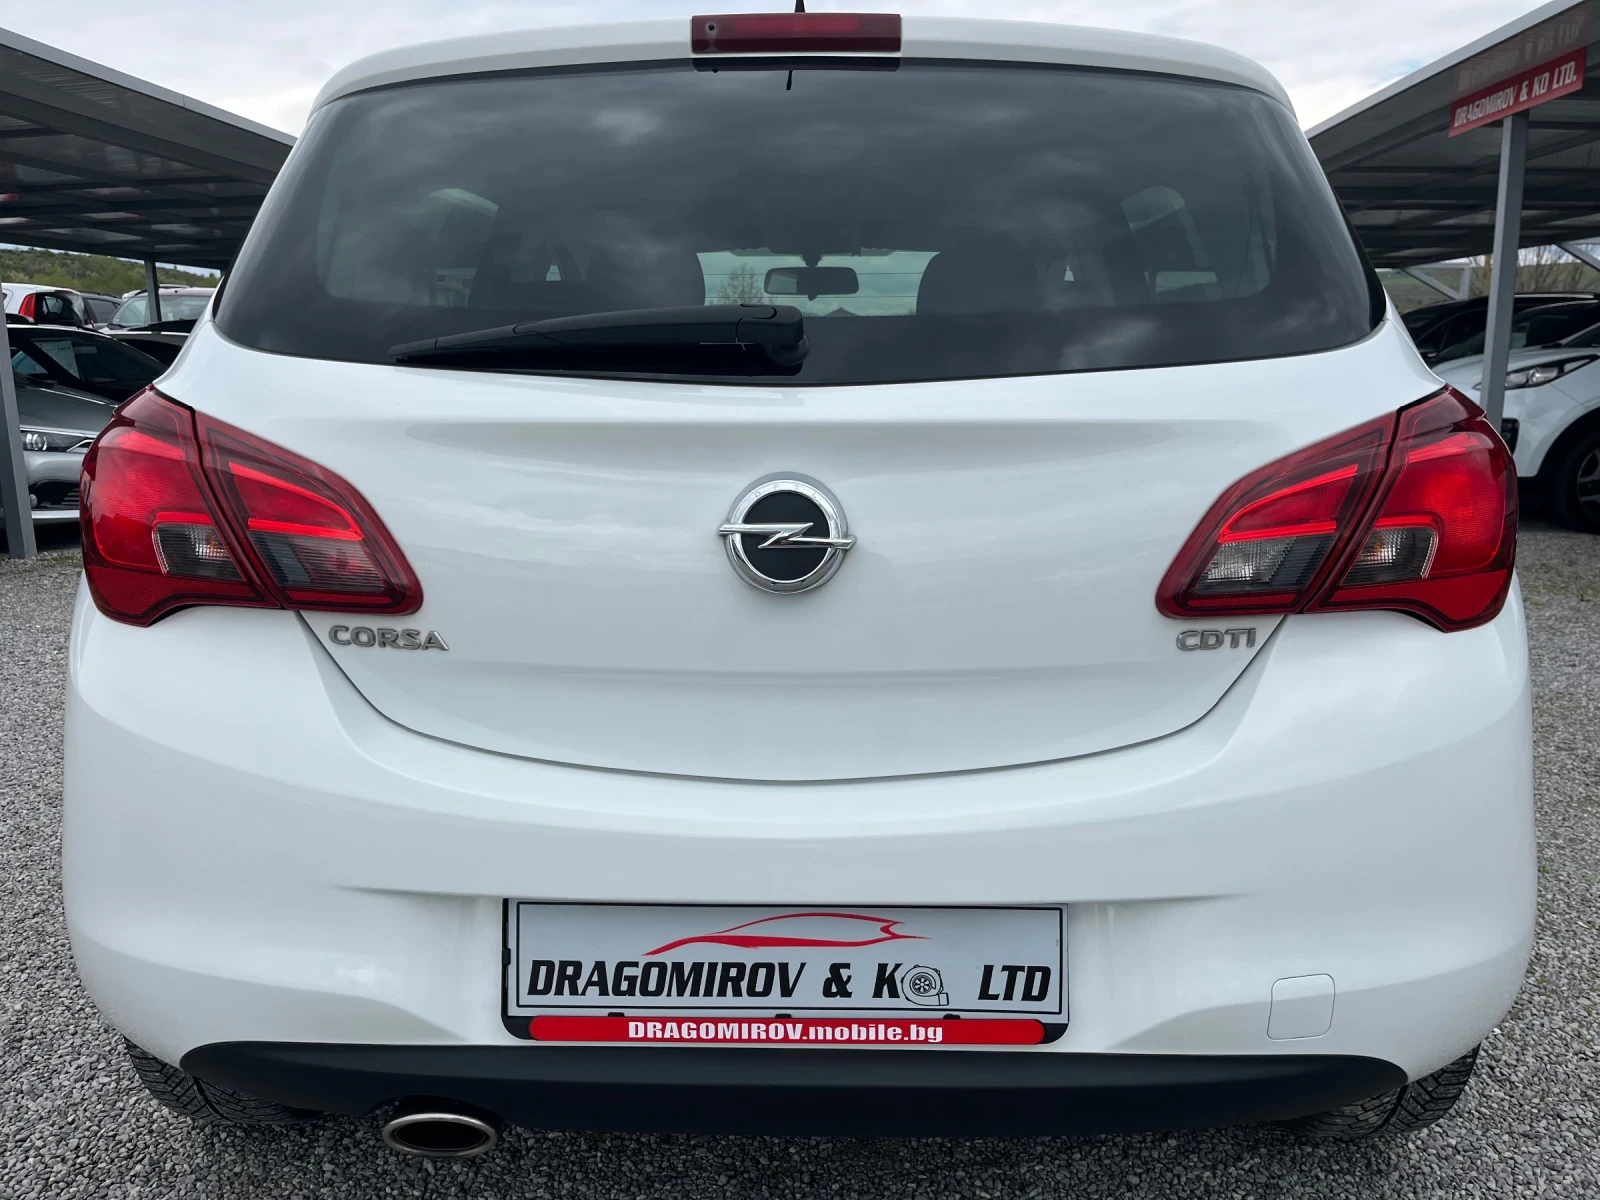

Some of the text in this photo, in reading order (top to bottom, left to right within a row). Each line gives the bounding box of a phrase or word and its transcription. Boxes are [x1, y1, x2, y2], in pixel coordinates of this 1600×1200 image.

[1454, 61, 1577, 127] DRAGOMIROV & KO LTD.
[754, 483, 817, 498] OPEL
[328, 625, 449, 650] CORSA
[1176, 628, 1256, 651] CDTI
[527, 959, 807, 998] DRAGOMIROV
[822, 962, 853, 999] &
[978, 965, 1052, 1002] LTD
[628, 1021, 943, 1042] DRAGOMIROV.mobile.bg
